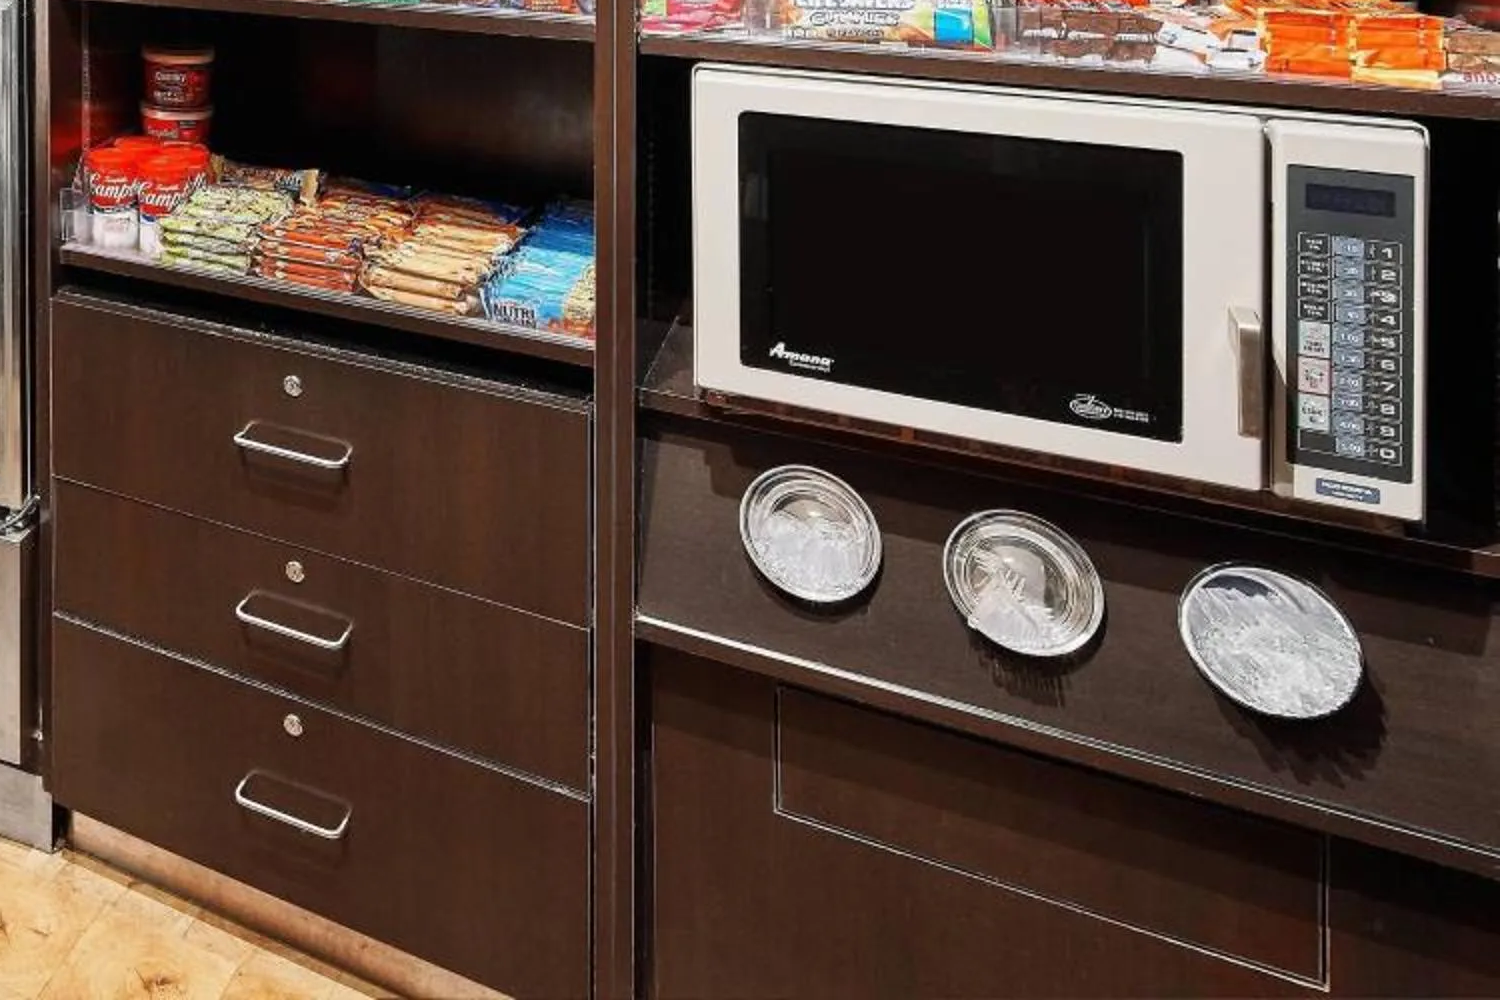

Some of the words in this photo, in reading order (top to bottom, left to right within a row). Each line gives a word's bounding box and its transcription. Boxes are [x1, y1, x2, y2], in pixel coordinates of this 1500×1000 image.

[1381, 268, 1397, 281] 2
[1381, 314, 1397, 326] 4
[1381, 336, 1396, 349] 5
[769, 341, 831, 366] Amana
[1381, 358, 1396, 372] 6
[1380, 381, 1396, 393] 7
[1380, 403, 1396, 416] 8
[1380, 447, 1396, 460] 0
